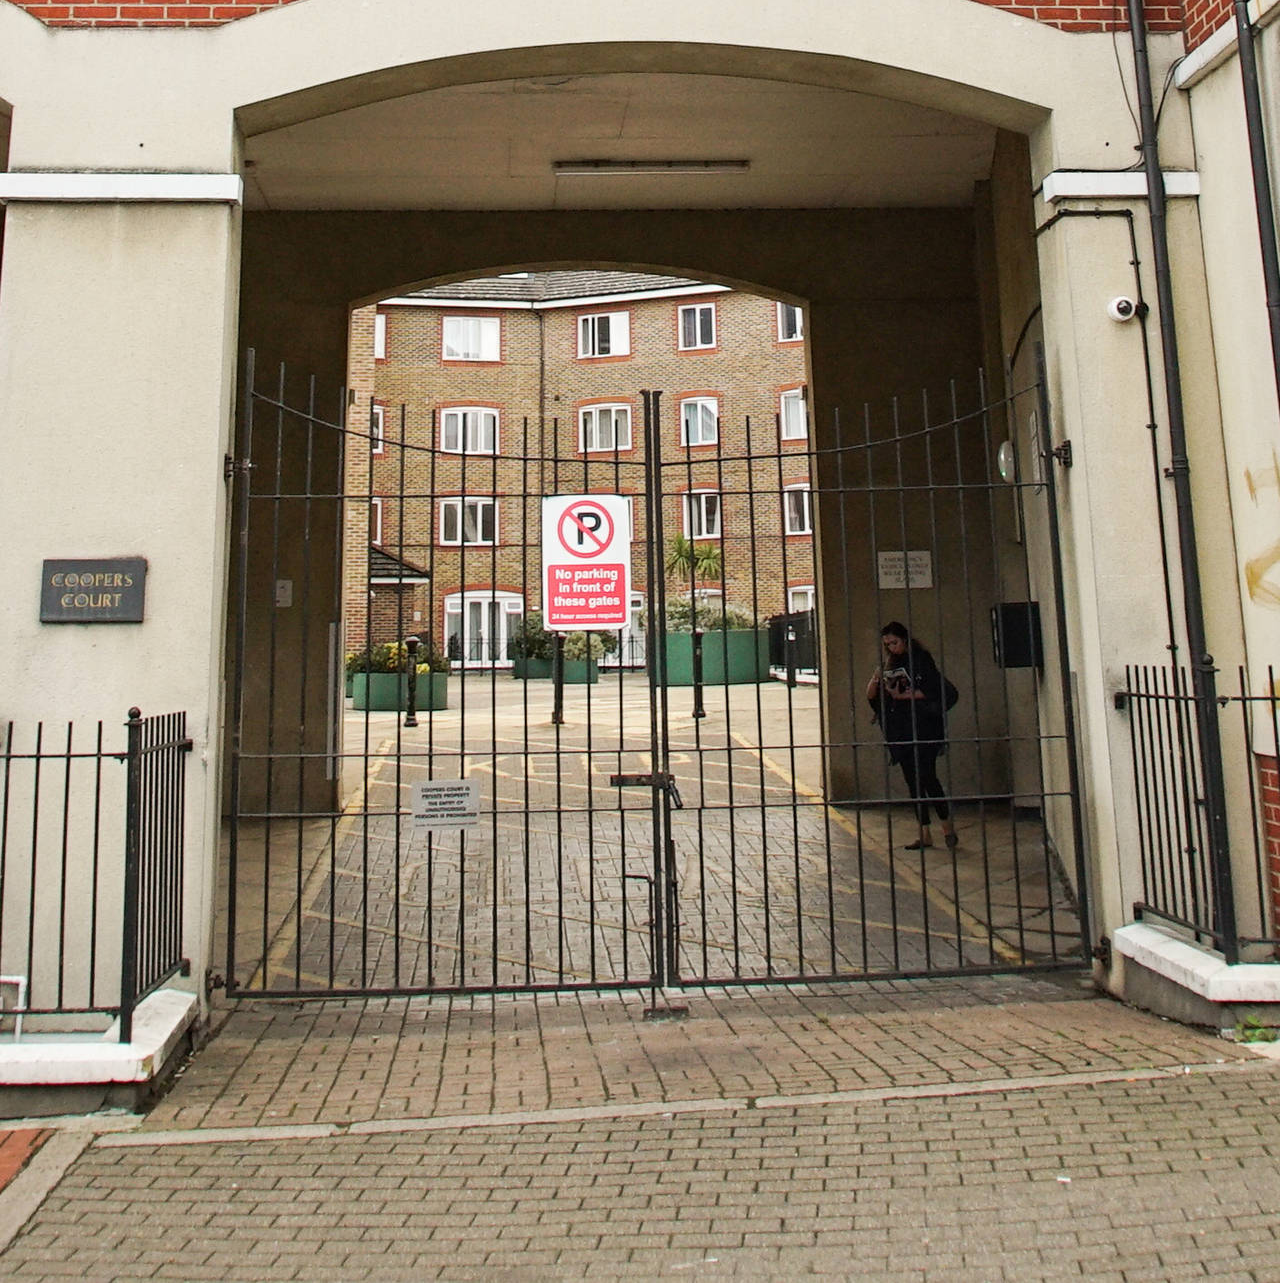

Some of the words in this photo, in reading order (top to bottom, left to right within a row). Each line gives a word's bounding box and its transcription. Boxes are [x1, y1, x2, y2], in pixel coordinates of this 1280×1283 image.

[50, 572, 134, 587] COOPERS
[555, 569, 572, 579] No
[574, 568, 618, 581] parking
[559, 582, 570, 593] in
[572, 582, 601, 593] front
[602, 581, 616, 592] of
[61, 593, 122, 608] COURT
[554, 596, 586, 606] these
[588, 595, 620, 608] gates
